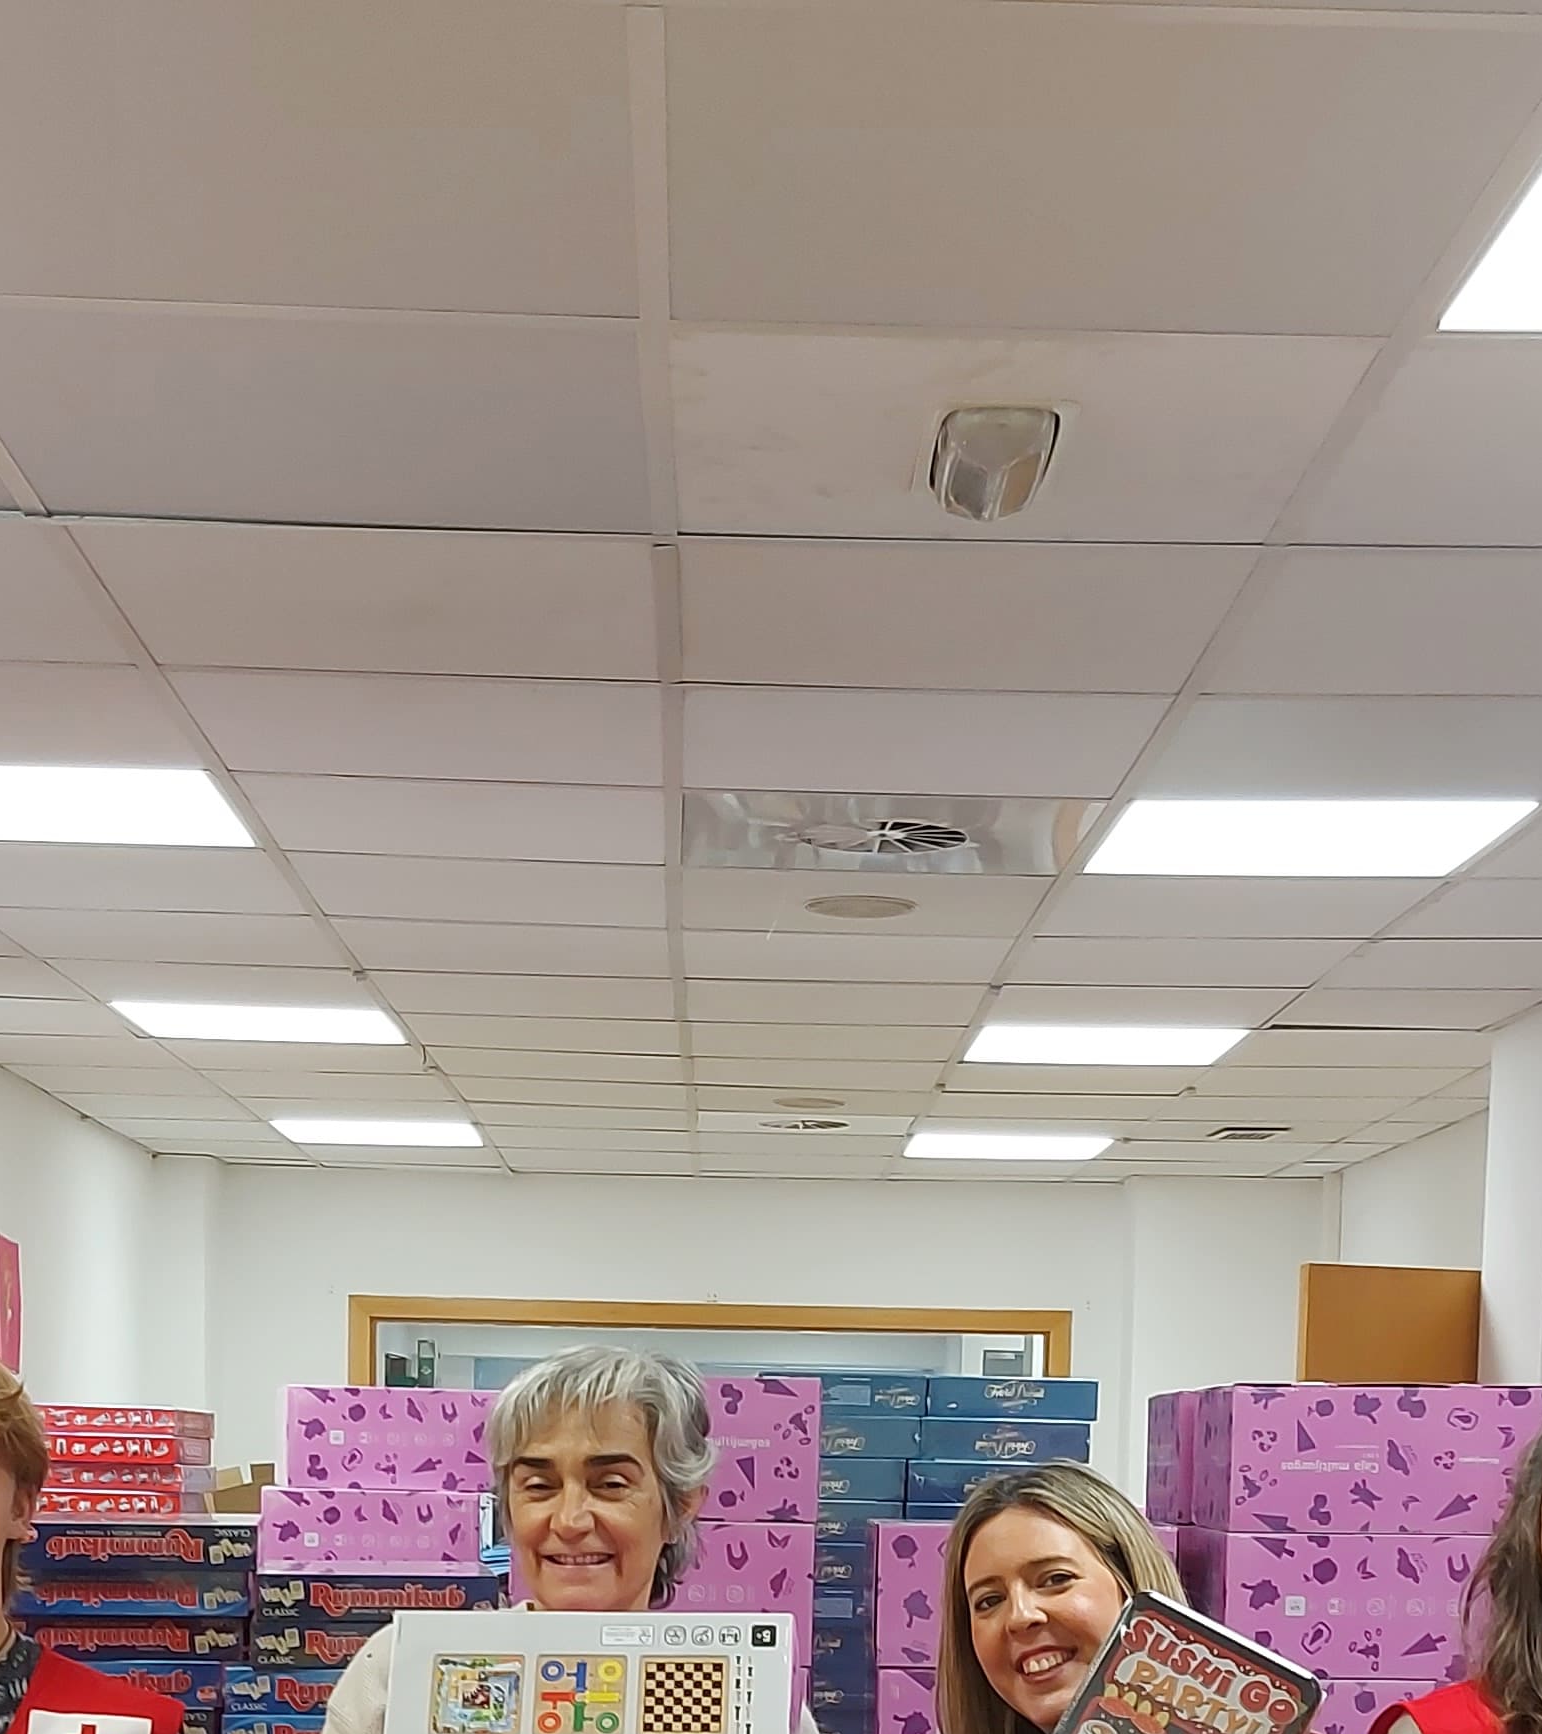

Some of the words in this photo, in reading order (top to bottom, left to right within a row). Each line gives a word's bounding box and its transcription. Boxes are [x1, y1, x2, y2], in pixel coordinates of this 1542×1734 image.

[45, 1528, 205, 1563] Rummikub
[310, 1582, 466, 1617] Rummikub
[1240, 1679, 1298, 1726] GO
